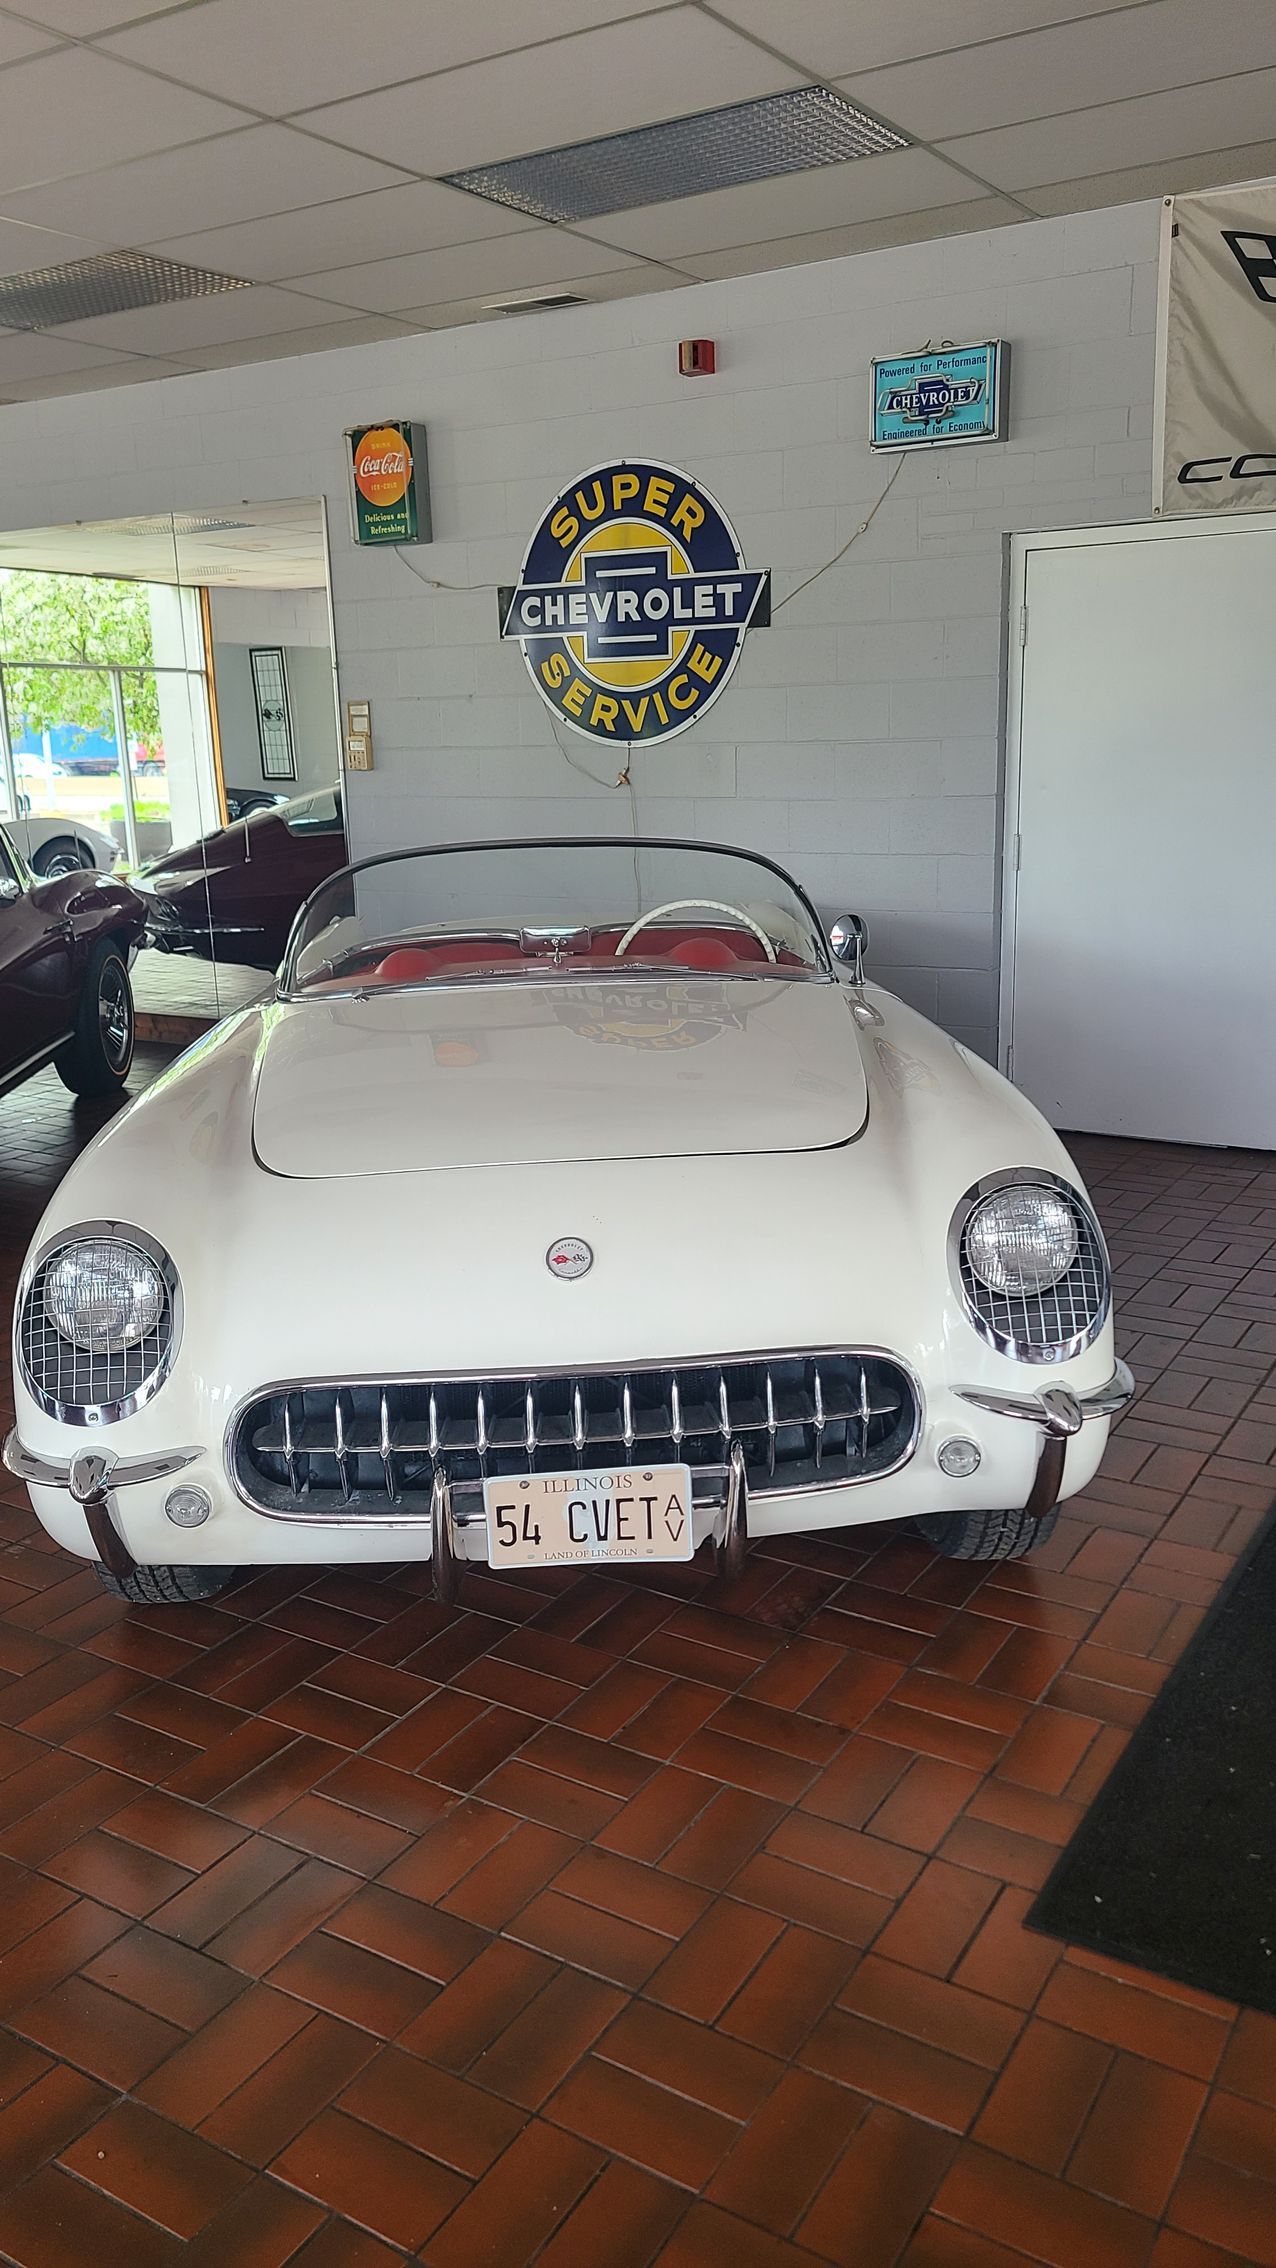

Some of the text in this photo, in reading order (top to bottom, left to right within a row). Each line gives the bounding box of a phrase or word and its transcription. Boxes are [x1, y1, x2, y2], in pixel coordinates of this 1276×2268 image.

[879, 355, 987, 379] Powered for Performanc
[893, 387, 976, 408] CHEVROLET
[882, 426, 927, 441] Engineered
[932, 425, 944, 434] for
[364, 513, 395, 523] Delicious
[550, 473, 706, 549] SUPER
[370, 524, 406, 535] Refreshing
[520, 582, 743, 628] CHEVROLET
[540, 642, 724, 733] SERVICE
[542, 1474, 633, 1494] ILLINOIS
[496, 1496, 658, 1547] 54 CVET
[544, 1548, 638, 1561] LAND OF LINCOLN
